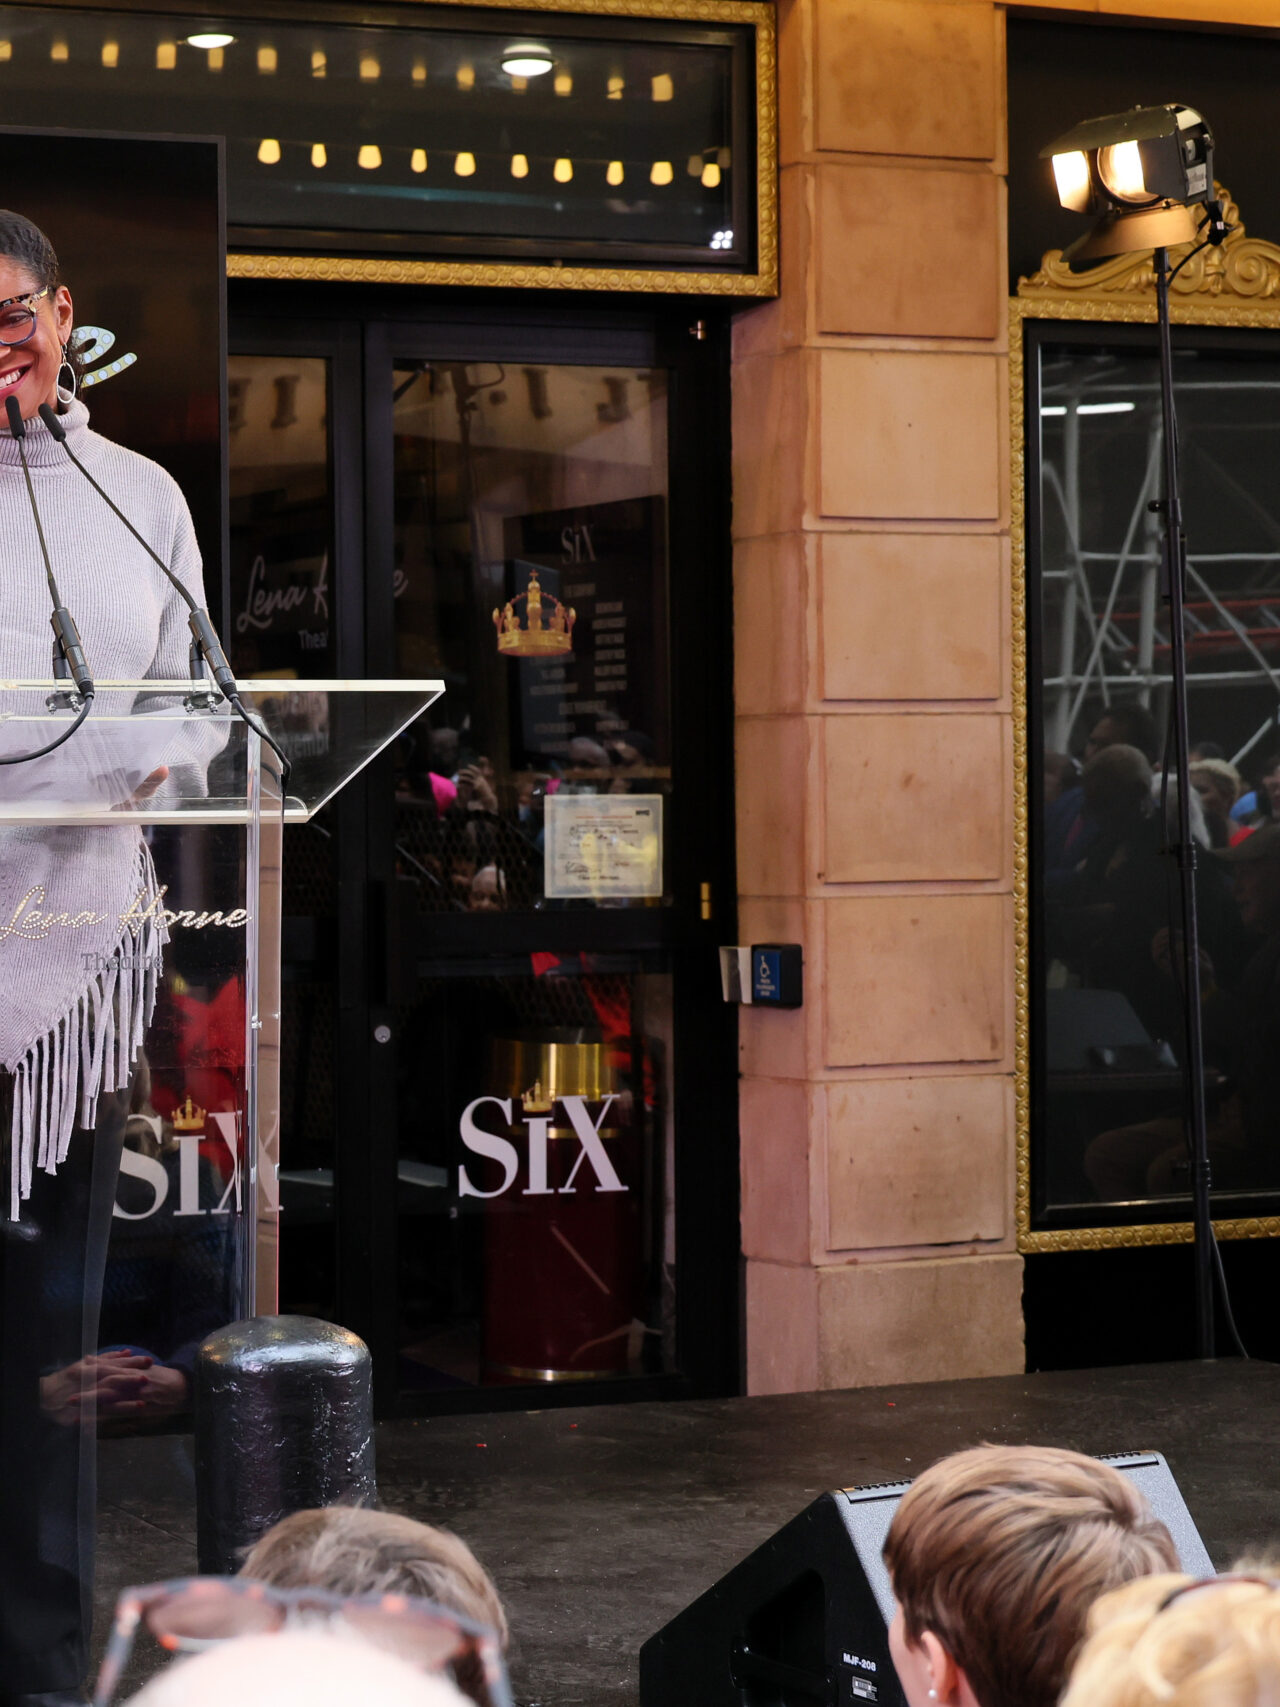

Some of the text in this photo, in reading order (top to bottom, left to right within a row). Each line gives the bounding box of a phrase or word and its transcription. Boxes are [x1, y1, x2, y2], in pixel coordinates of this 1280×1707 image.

[298, 629, 328, 649] Thea
[117, 884, 253, 937] Horne
[80, 952, 164, 971] Theatre
[843, 1652, 877, 1672] MJF-208
